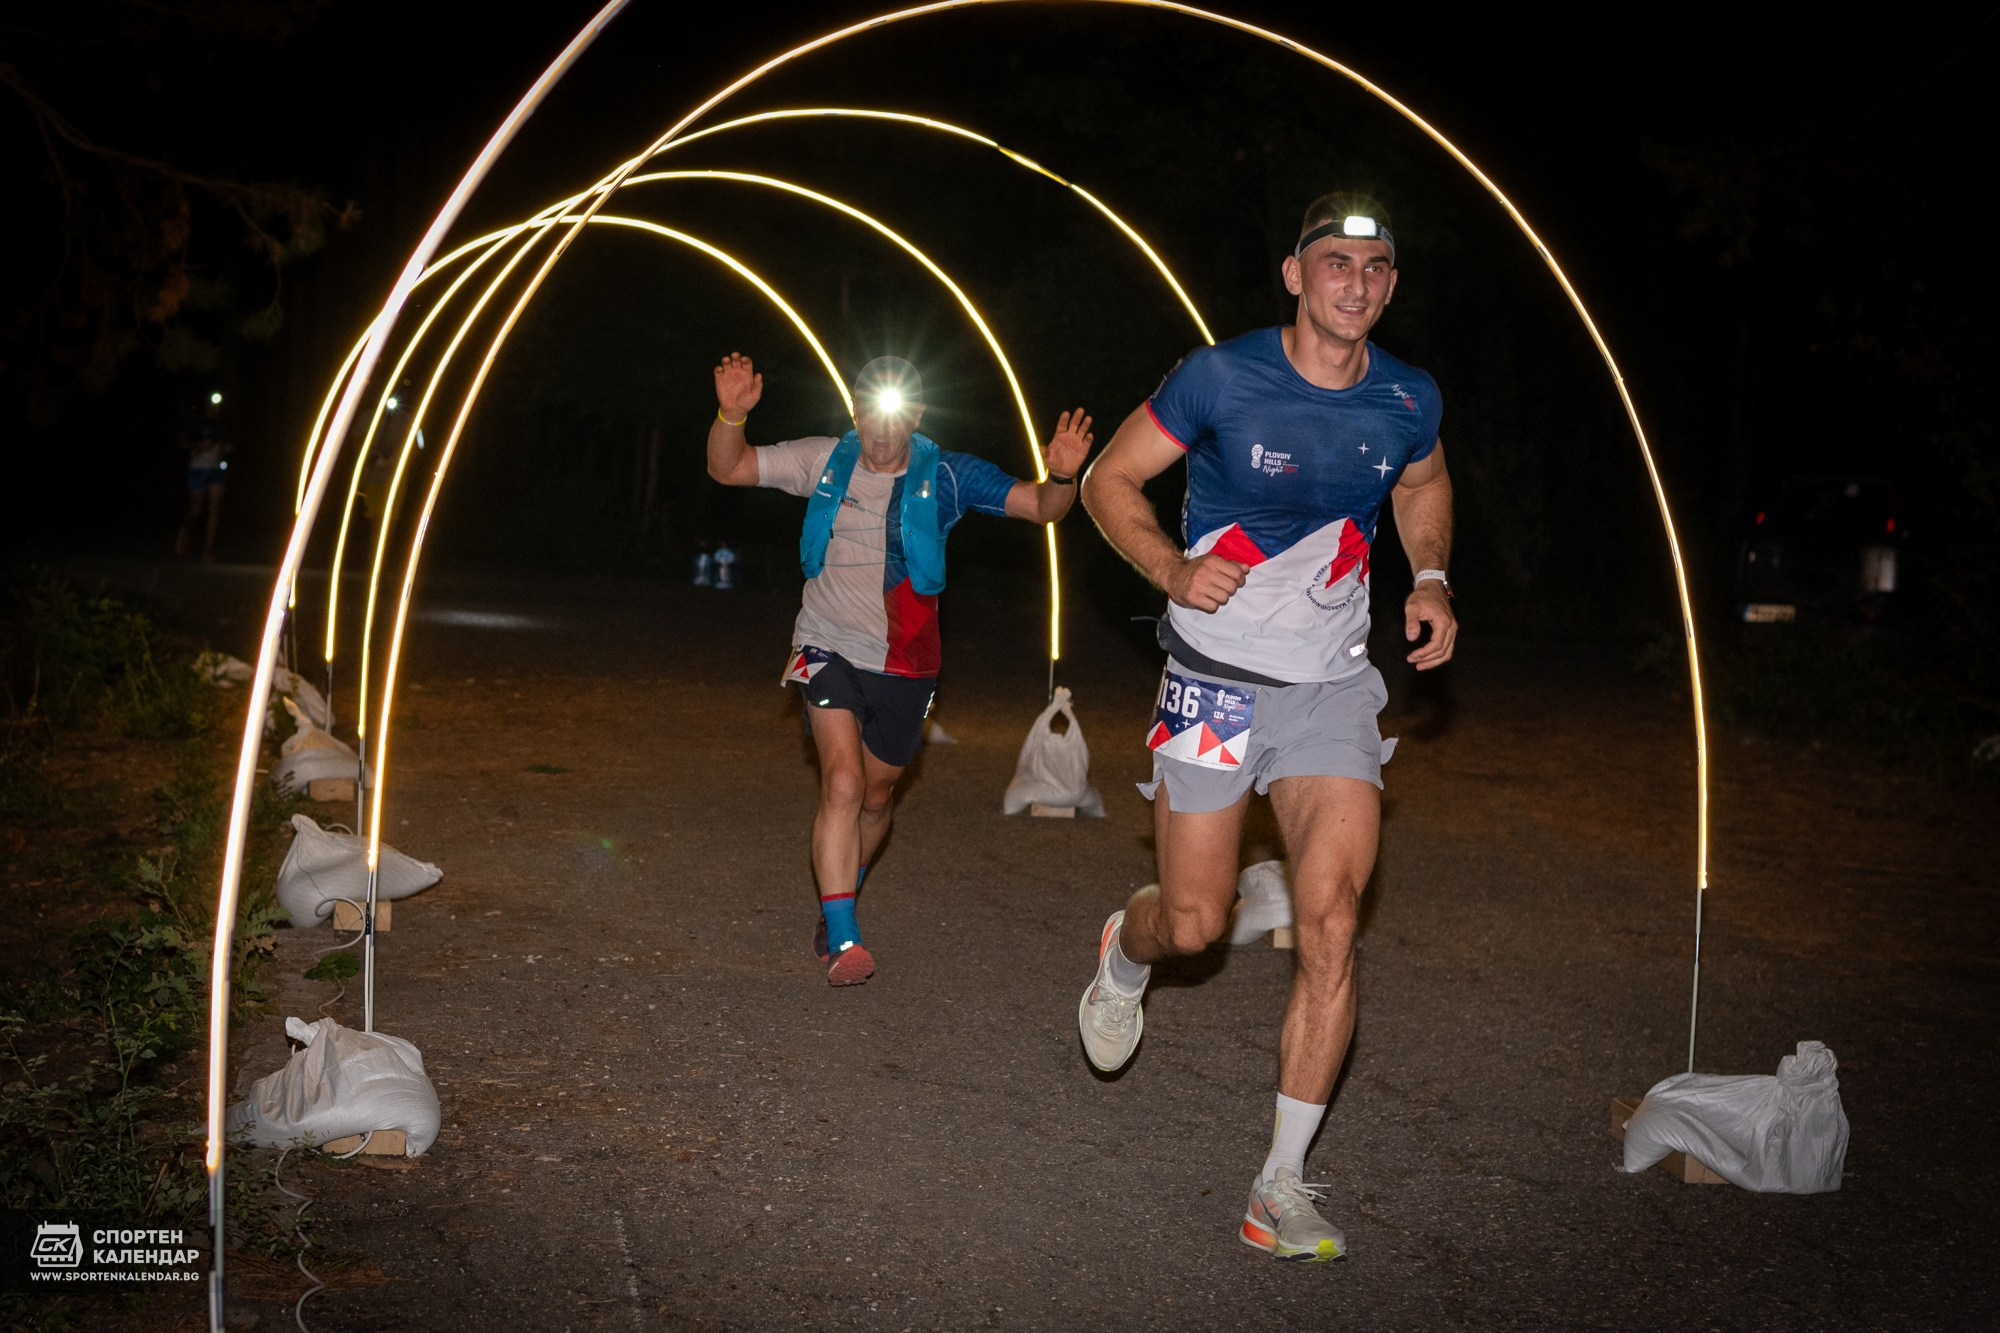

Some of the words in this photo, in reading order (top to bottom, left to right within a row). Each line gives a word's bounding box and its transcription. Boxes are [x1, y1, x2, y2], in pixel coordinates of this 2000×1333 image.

[1265, 451, 1291, 460] PLOVDIV
[1264, 458, 1282, 466] HILLS
[1262, 465, 1284, 477] Night
[1213, 711, 1225, 720] 12K
